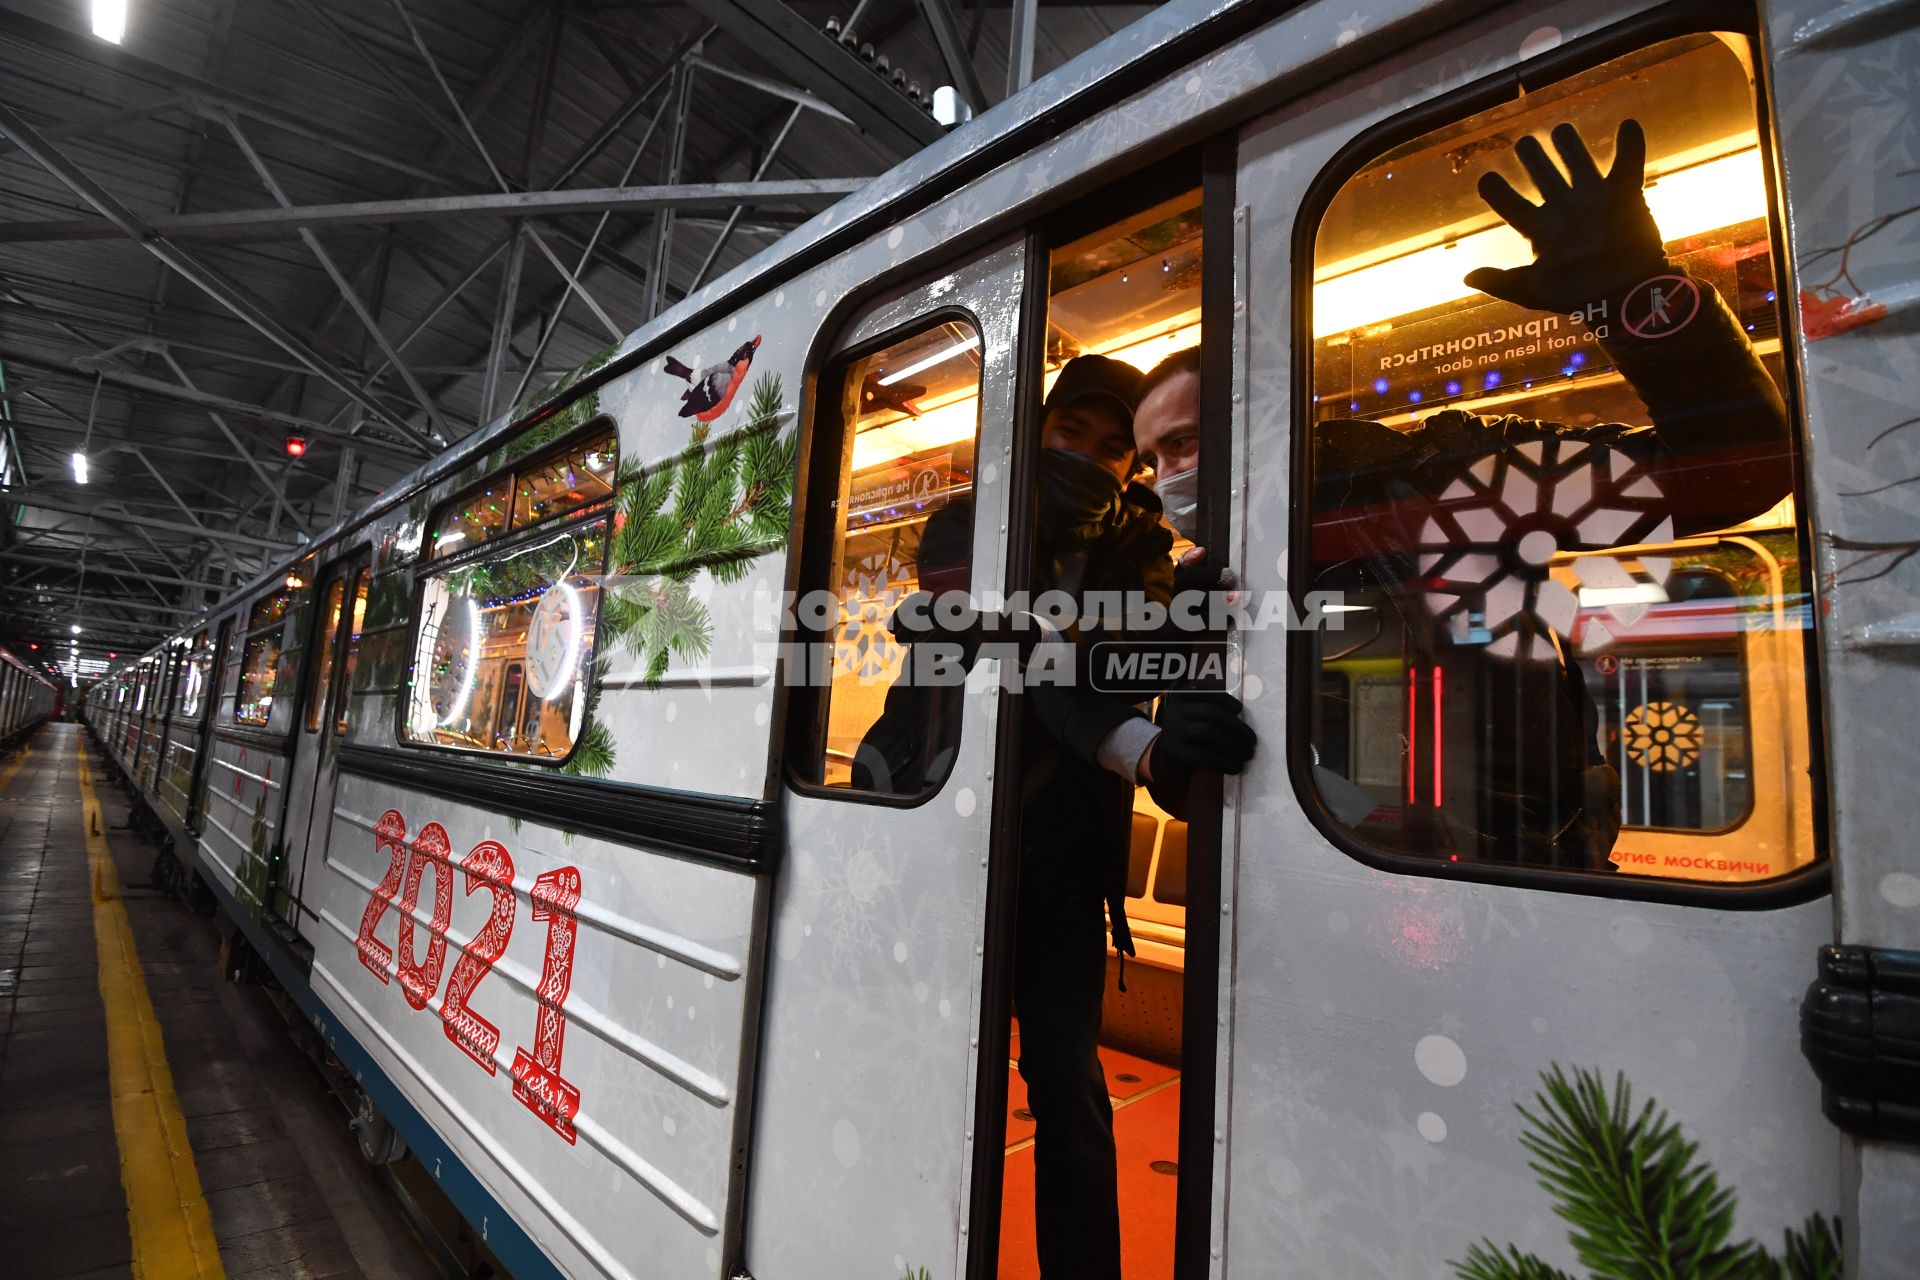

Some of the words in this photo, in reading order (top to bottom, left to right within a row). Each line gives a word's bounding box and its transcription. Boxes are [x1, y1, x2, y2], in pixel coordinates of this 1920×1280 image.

[1611, 851, 1656, 865] огие
[1664, 855, 1769, 874] москвичи
[354, 808, 582, 1146] 2021
